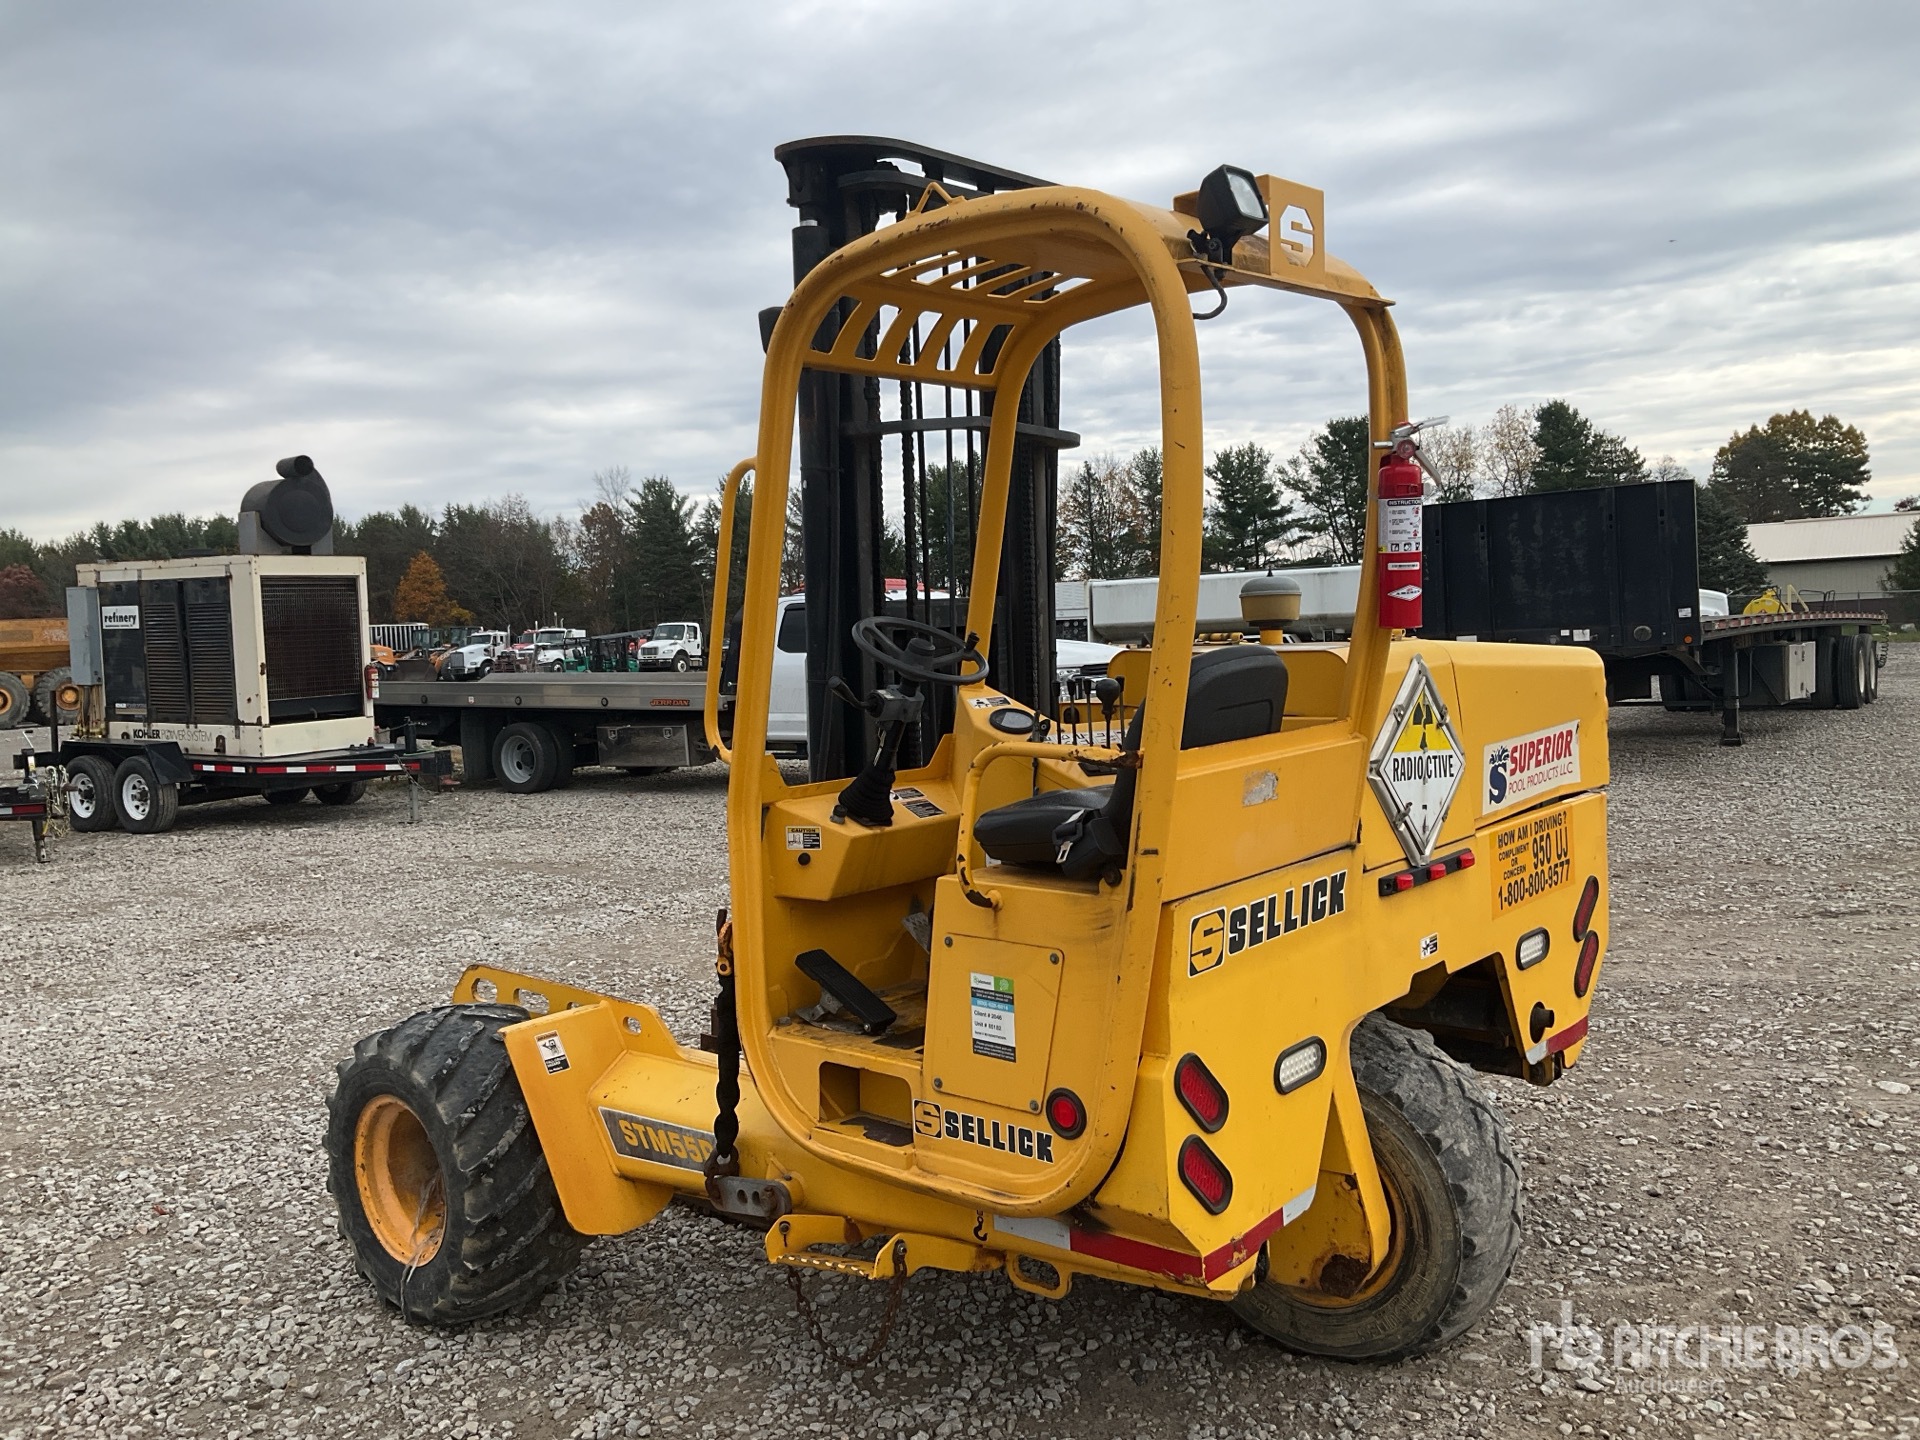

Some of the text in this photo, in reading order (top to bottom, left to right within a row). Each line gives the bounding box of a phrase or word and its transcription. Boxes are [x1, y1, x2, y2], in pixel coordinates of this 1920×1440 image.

[104, 611, 136, 625] refinery
[1509, 730, 1573, 777] SUPERIOR
[1508, 761, 1573, 795] POOL PRODUCTS LLC
[1498, 830, 1515, 849] HOW
[1517, 825, 1528, 841] AM
[1530, 823, 1533, 837] I
[1532, 826, 1569, 870] 950 UJ
[1498, 842, 1529, 862] COMPLIMENT
[1511, 857, 1518, 867] OR
[1498, 858, 1571, 911] 1-800-800-9577
[1503, 864, 1527, 881] CONCERN
[1228, 871, 1347, 955] SELLICK
[974, 1010, 986, 1018] Client
[944, 1109, 1055, 1164] SELLICK
